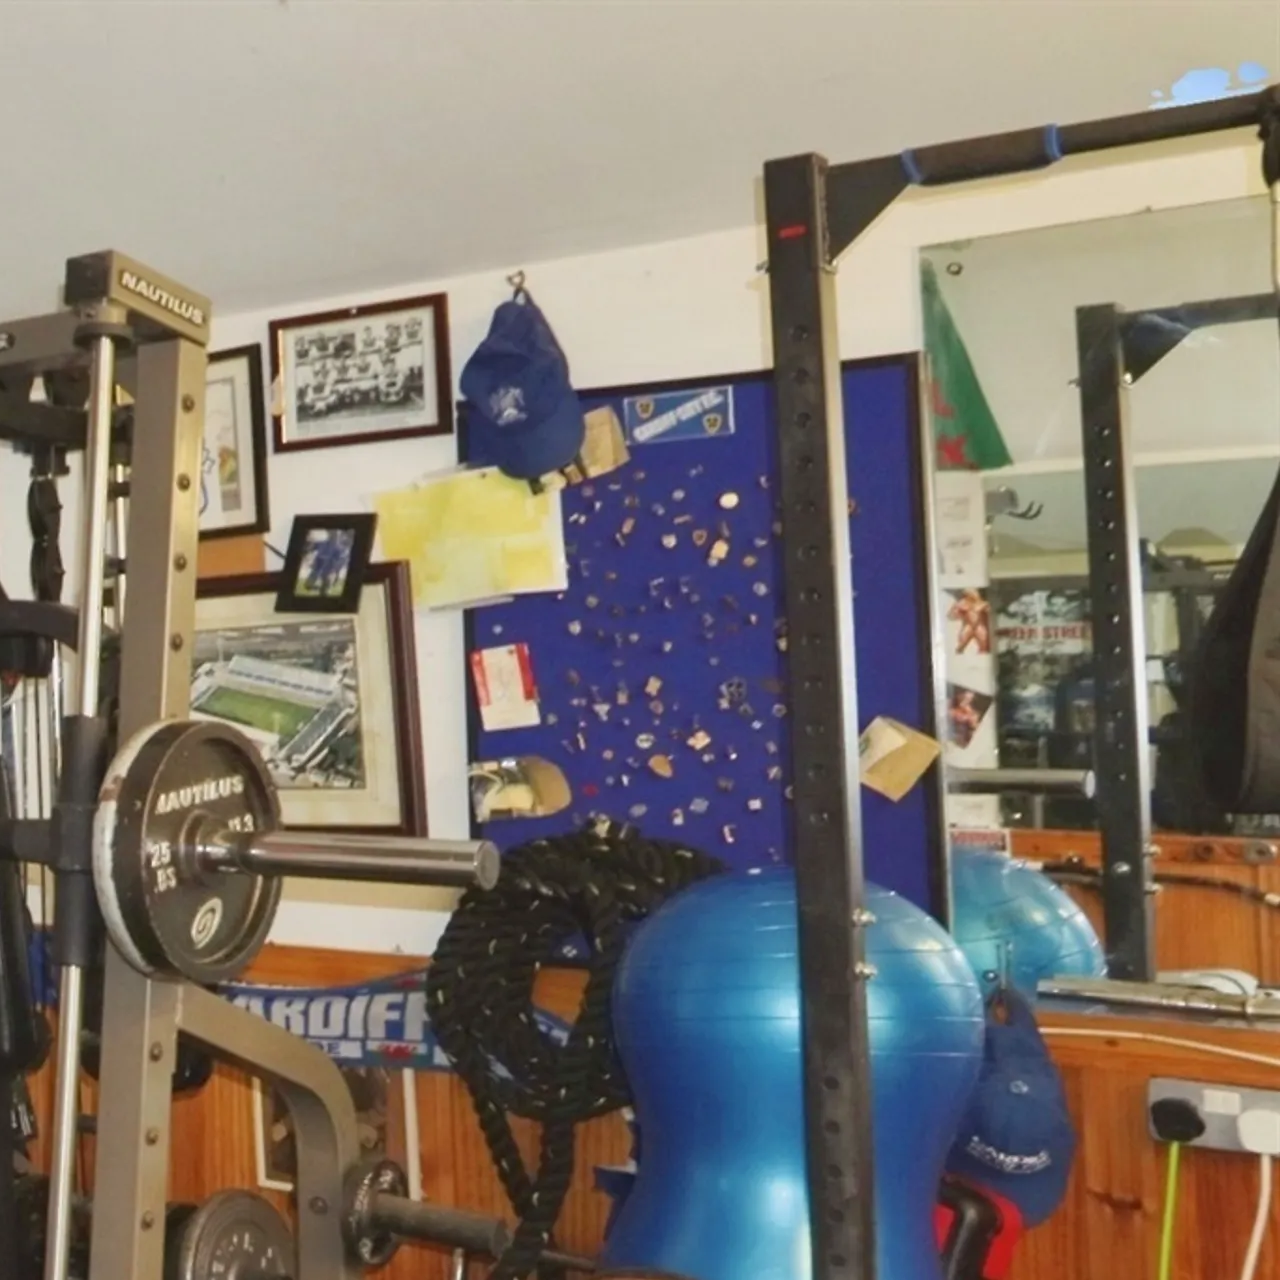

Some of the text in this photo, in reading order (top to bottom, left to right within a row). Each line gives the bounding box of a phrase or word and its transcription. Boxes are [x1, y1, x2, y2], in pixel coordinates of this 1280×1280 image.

[120, 271, 204, 325] NAUTILUS
[151, 841, 172, 869] 25
[153, 867, 178, 894] BS
[220, 990, 430, 1042] RDIFF
